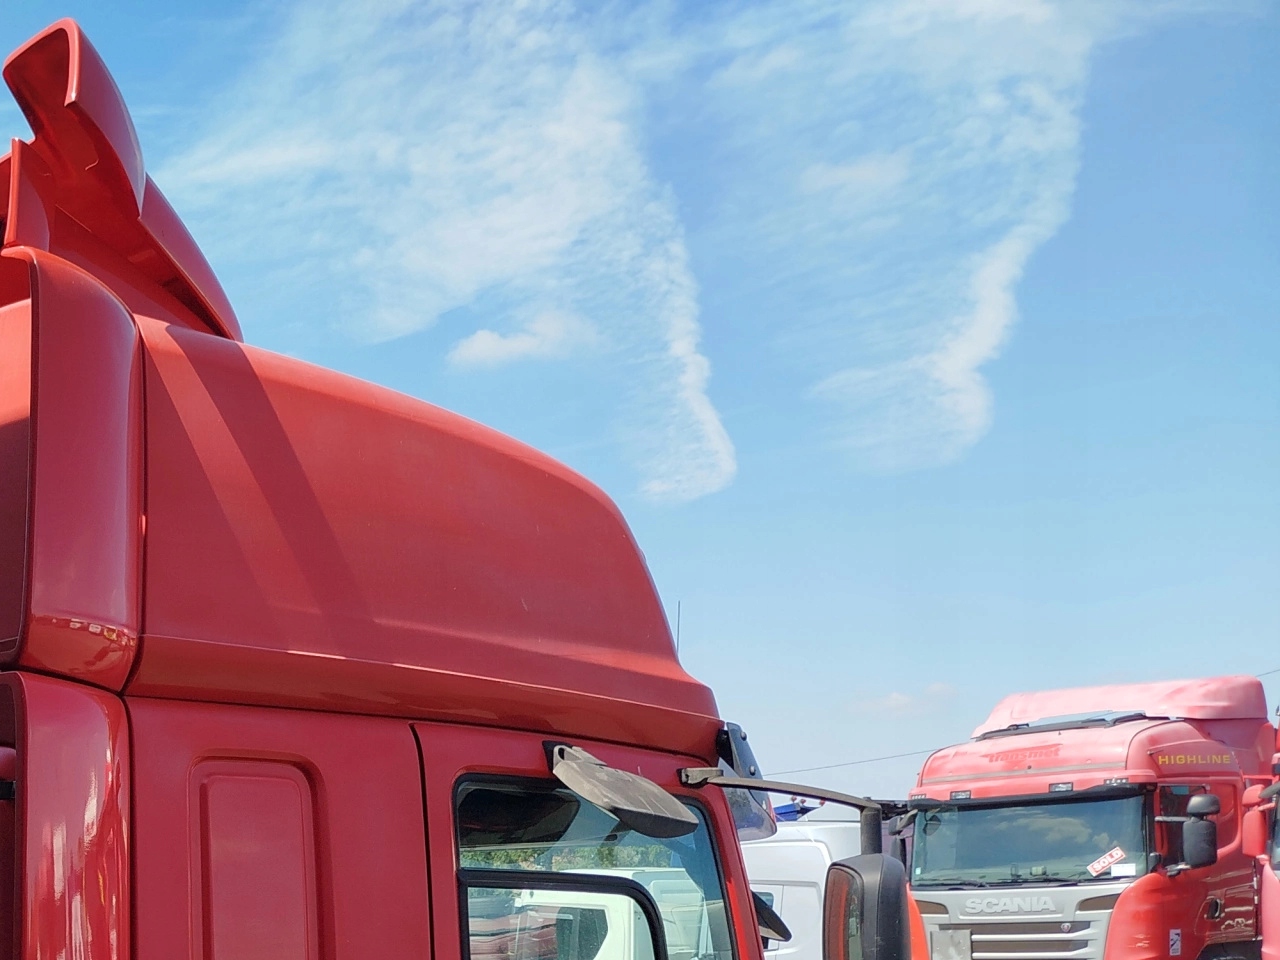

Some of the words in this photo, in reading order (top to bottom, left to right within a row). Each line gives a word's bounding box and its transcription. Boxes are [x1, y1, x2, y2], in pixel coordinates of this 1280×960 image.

[1158, 755, 1231, 765] HIGHLINE
[1092, 849, 1122, 871] SOLD
[965, 896, 1056, 914] SCANIA
